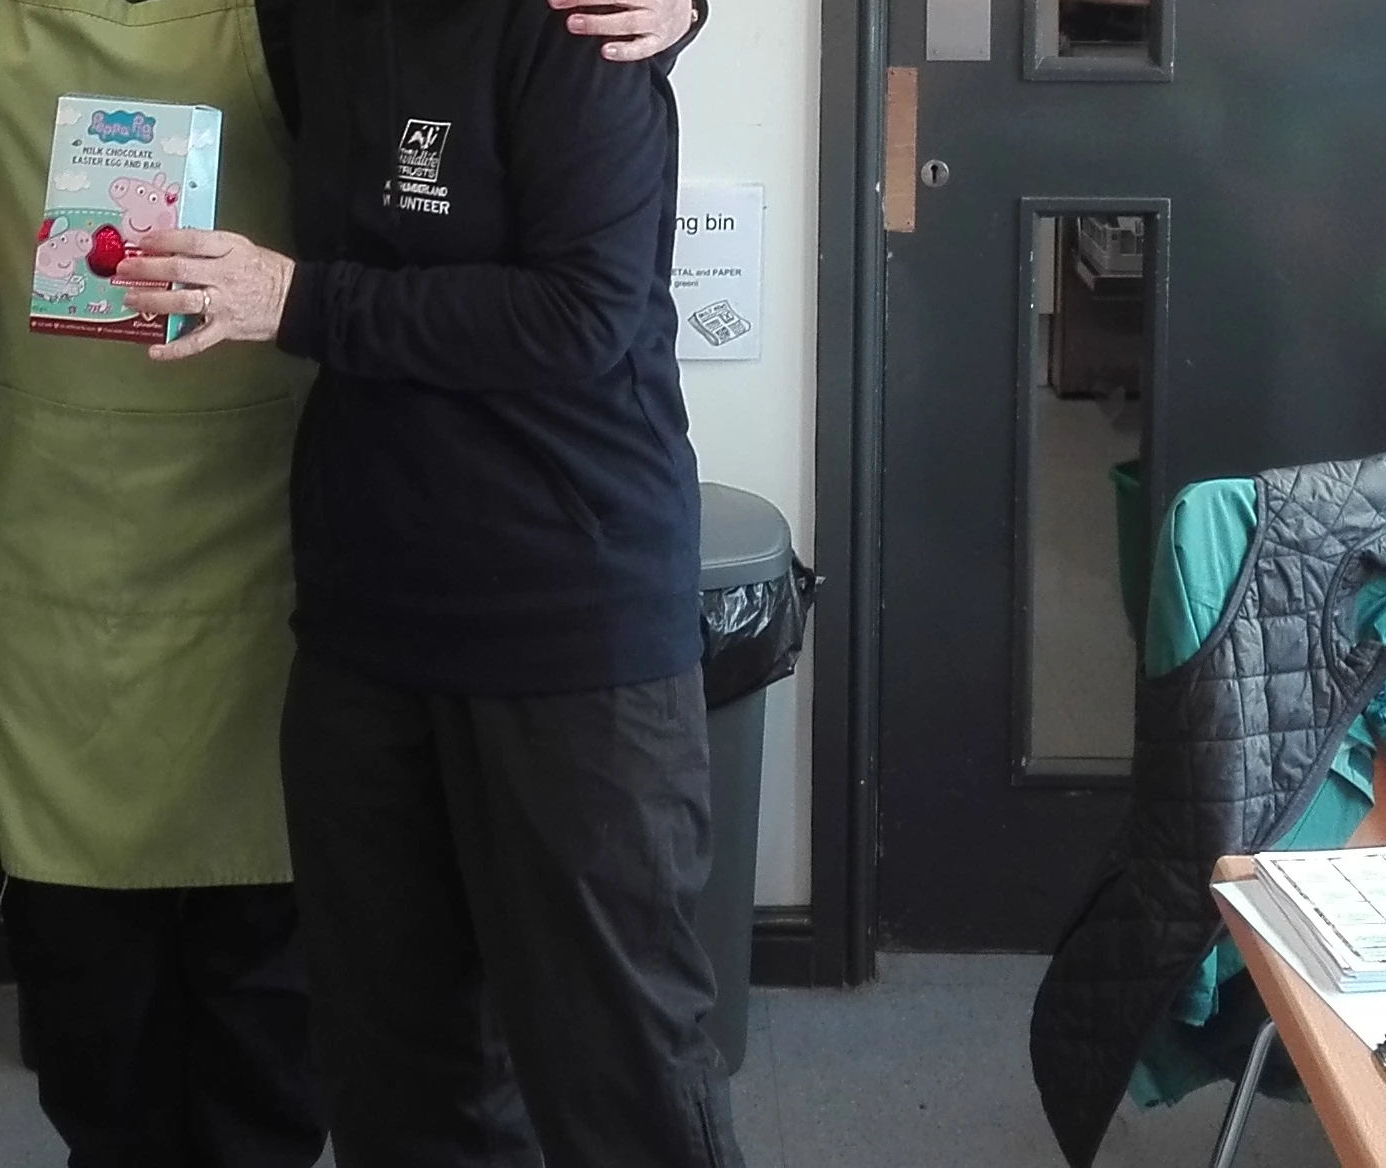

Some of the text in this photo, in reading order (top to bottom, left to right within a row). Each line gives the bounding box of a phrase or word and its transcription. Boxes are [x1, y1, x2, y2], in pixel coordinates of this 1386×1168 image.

[82, 147, 153, 159] MILK CHOCOLATE
[72, 156, 162, 170] EASTER EGG AND BAR
[705, 213, 734, 231] bin
[713, 269, 741, 277] PAPER
